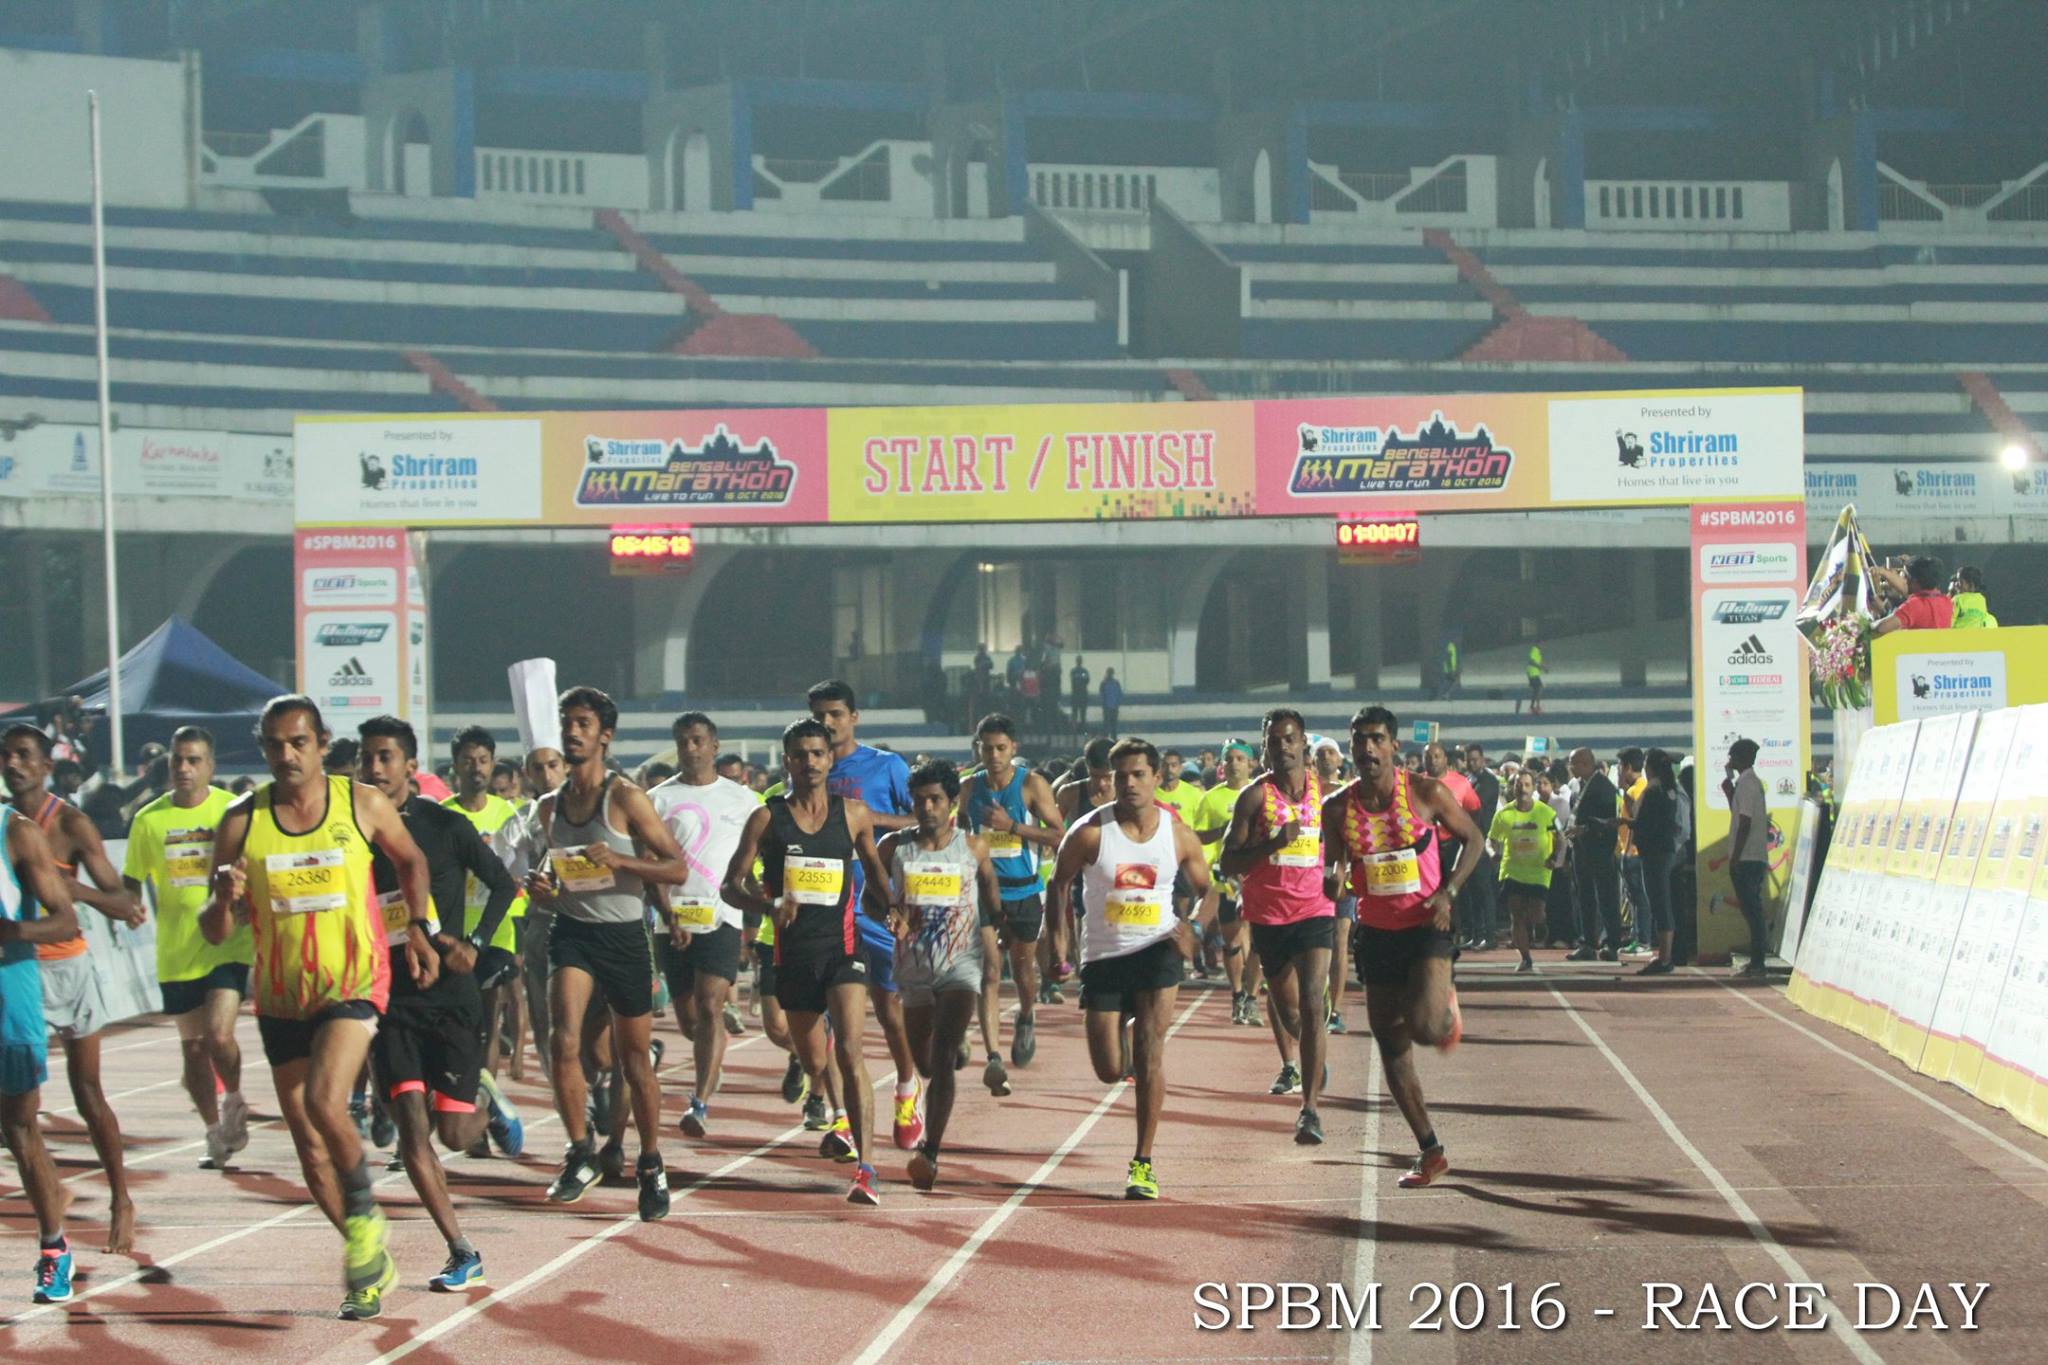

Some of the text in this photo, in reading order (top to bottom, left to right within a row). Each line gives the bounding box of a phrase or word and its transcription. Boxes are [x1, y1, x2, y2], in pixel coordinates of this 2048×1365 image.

[1641, 406, 1712, 419] Presented by
[383, 430, 453, 442] Presented by
[1322, 428, 1377, 443] Shriram
[607, 441, 662, 456] Shriram
[1650, 431, 1738, 454] Shriram
[392, 453, 477, 477] Shriram
[865, 432, 1215, 493] START / FINISH
[1650, 455, 1738, 468] Properties
[391, 479, 477, 490] Properties
[1617, 474, 1739, 488] Homes that live in you
[1917, 470, 1976, 487] Shriram
[1700, 510, 1796, 526] #SPBM2016
[1339, 523, 1418, 544] 01:00:07
[304, 534, 396, 549] #SPBM2016
[1757, 554, 1788, 565] Sports
[1727, 614, 1759, 623] TITAN
[1727, 653, 1773, 666] adidas
[329, 676, 373, 687] adidas
[1934, 673, 1992, 689] Shriram
[1934, 690, 1992, 699] Properties
[1374, 864, 1408, 877] 22008
[797, 871, 833, 884] 23553
